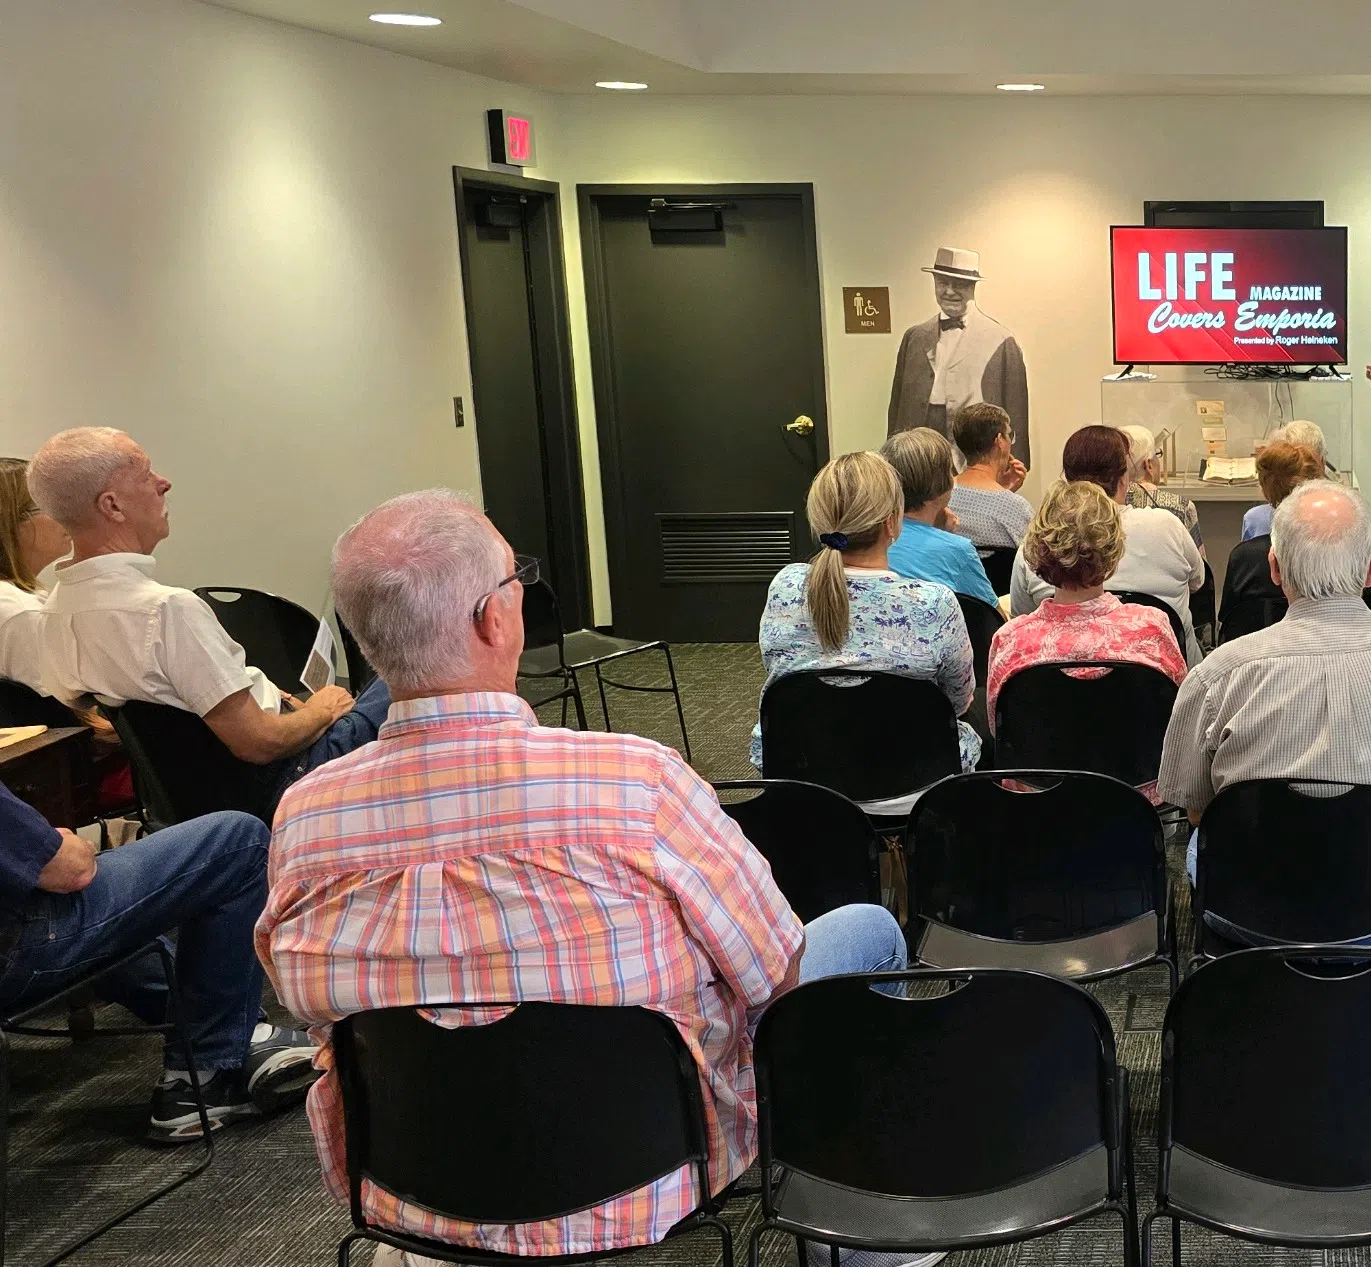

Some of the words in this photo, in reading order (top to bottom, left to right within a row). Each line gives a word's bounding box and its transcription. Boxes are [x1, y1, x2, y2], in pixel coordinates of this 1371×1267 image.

[1138, 252, 1236, 300] LIFE
[1250, 286, 1322, 301] MAGAZINE
[1147, 301, 1225, 334] Covers
[1234, 301, 1336, 335] Emporia
[1233, 336, 1265, 345] Presented
[1266, 336, 1275, 346] by
[1275, 335, 1299, 346] Roger
[1300, 335, 1338, 345] Heineken
